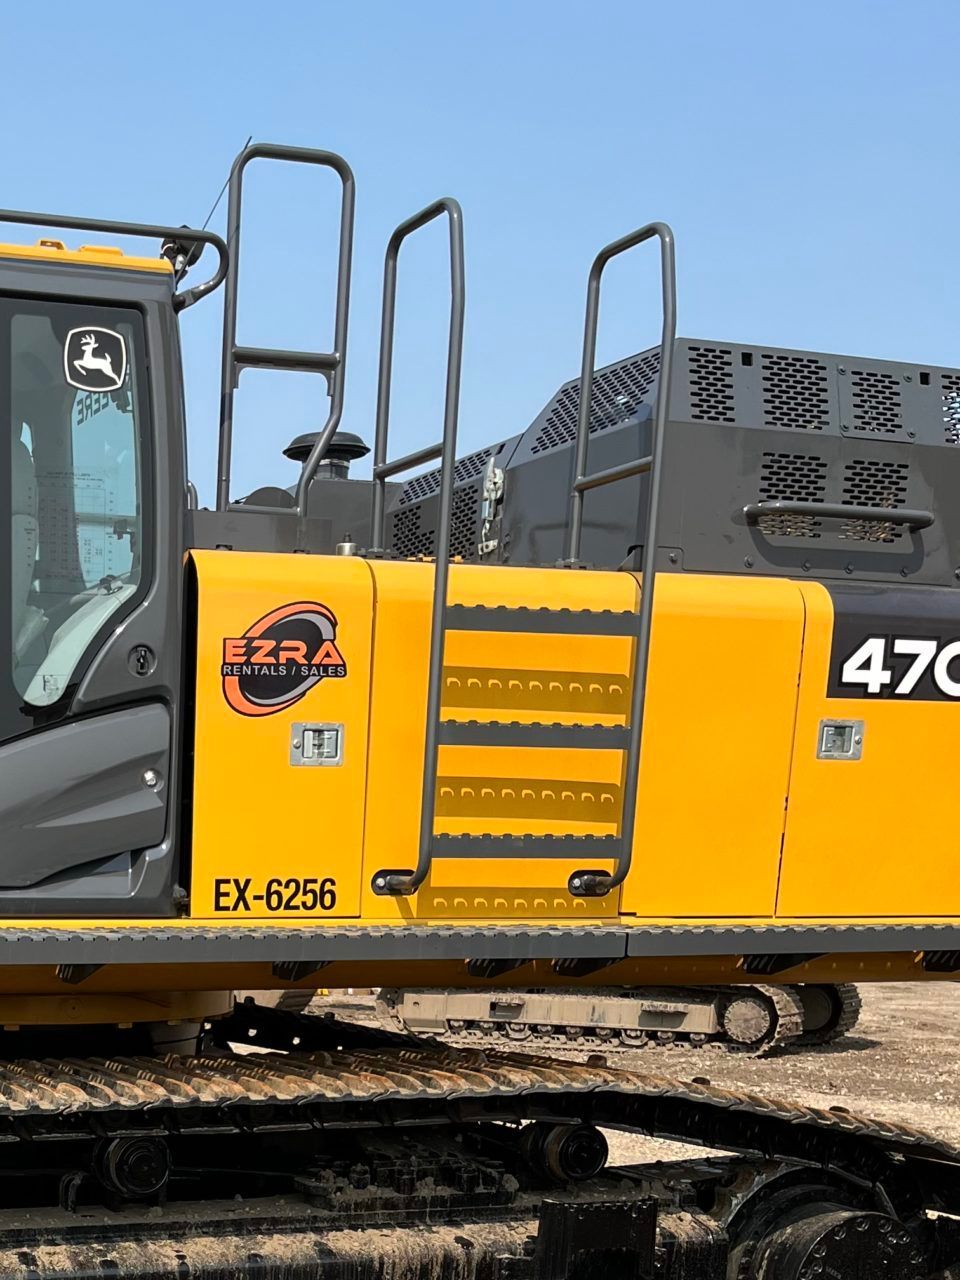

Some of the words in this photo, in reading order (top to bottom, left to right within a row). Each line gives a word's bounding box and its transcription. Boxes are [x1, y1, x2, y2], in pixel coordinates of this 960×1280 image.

[225, 639, 344, 665] EZRA
[223, 664, 287, 676] RENTALS
[300, 666, 345, 677] SALES
[214, 877, 337, 912] EX-6256
